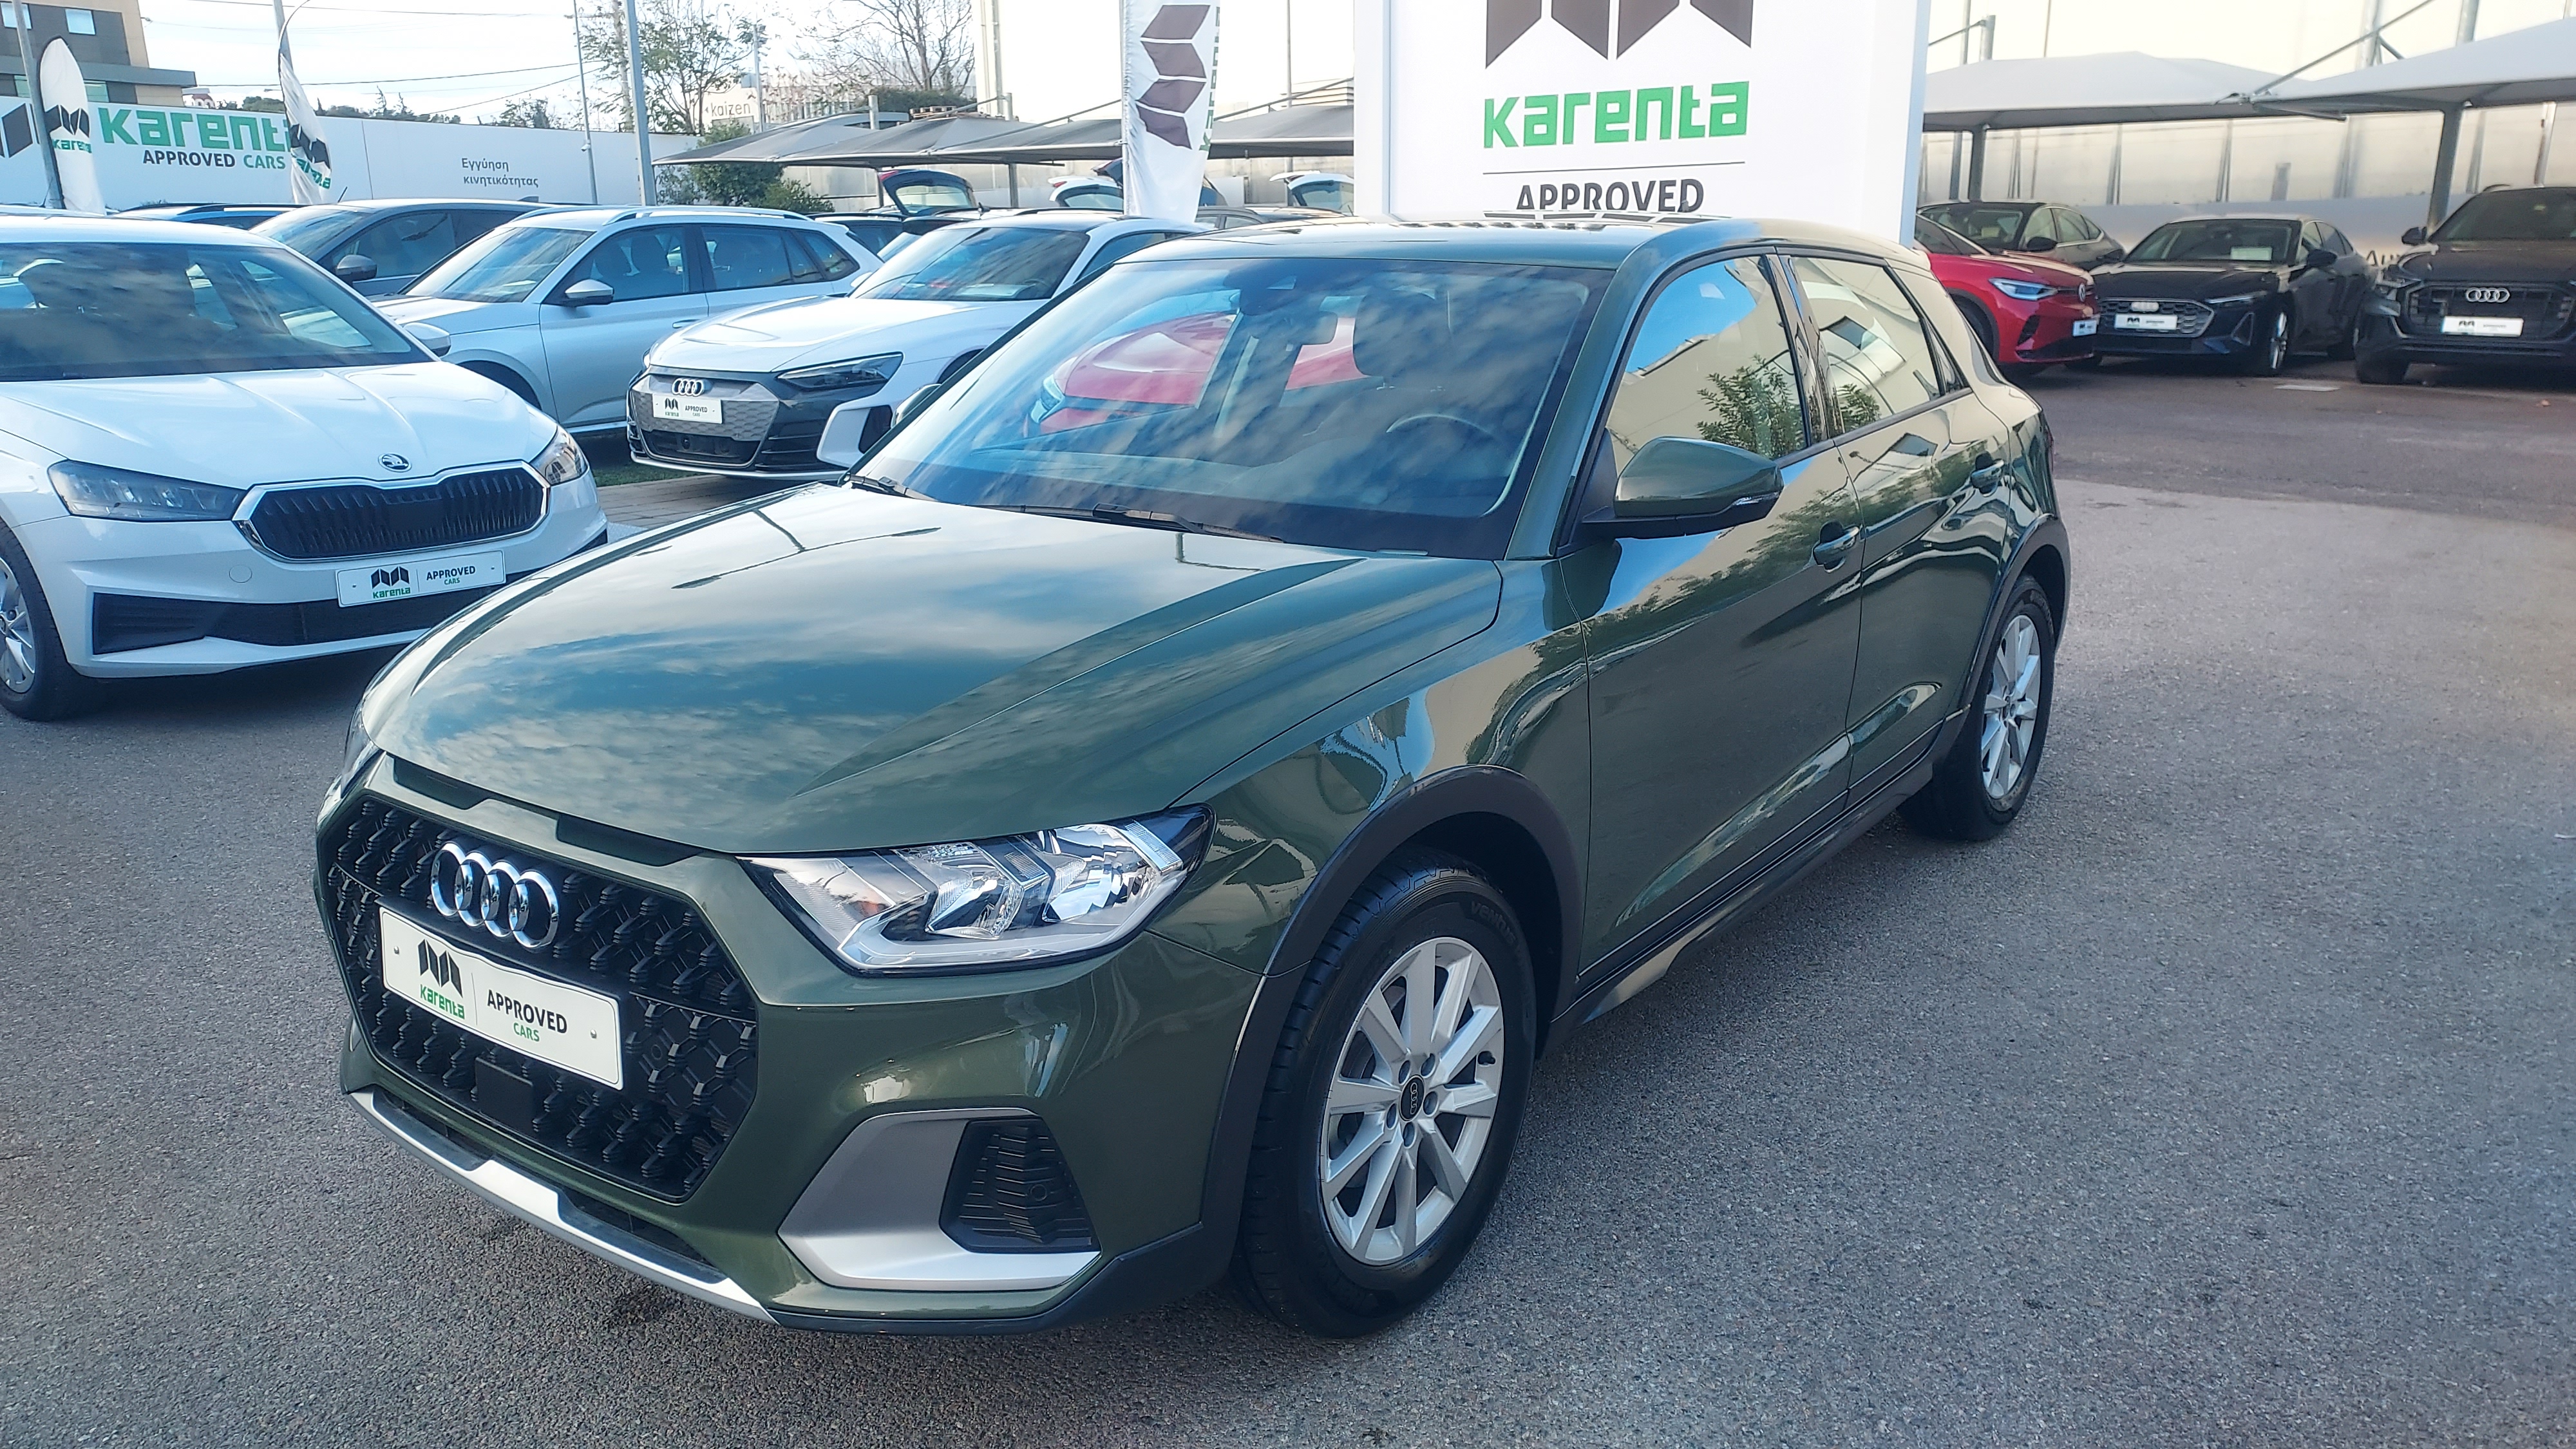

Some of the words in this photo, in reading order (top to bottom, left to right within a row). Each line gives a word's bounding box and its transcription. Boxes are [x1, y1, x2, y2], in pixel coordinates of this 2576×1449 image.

[711, 101, 751, 117] kaizen
[98, 108, 292, 152] karent
[143, 149, 236, 167] APPROVED
[243, 155, 286, 169] CARS
[462, 158, 509, 172] Εγγύηση
[464, 175, 539, 188] κινητικότητας
[1516, 178, 1704, 213] APPROVED
[426, 565, 476, 581] APPROVED
[487, 989, 567, 1034] APPROVED
[513, 1022, 540, 1043] CARS
